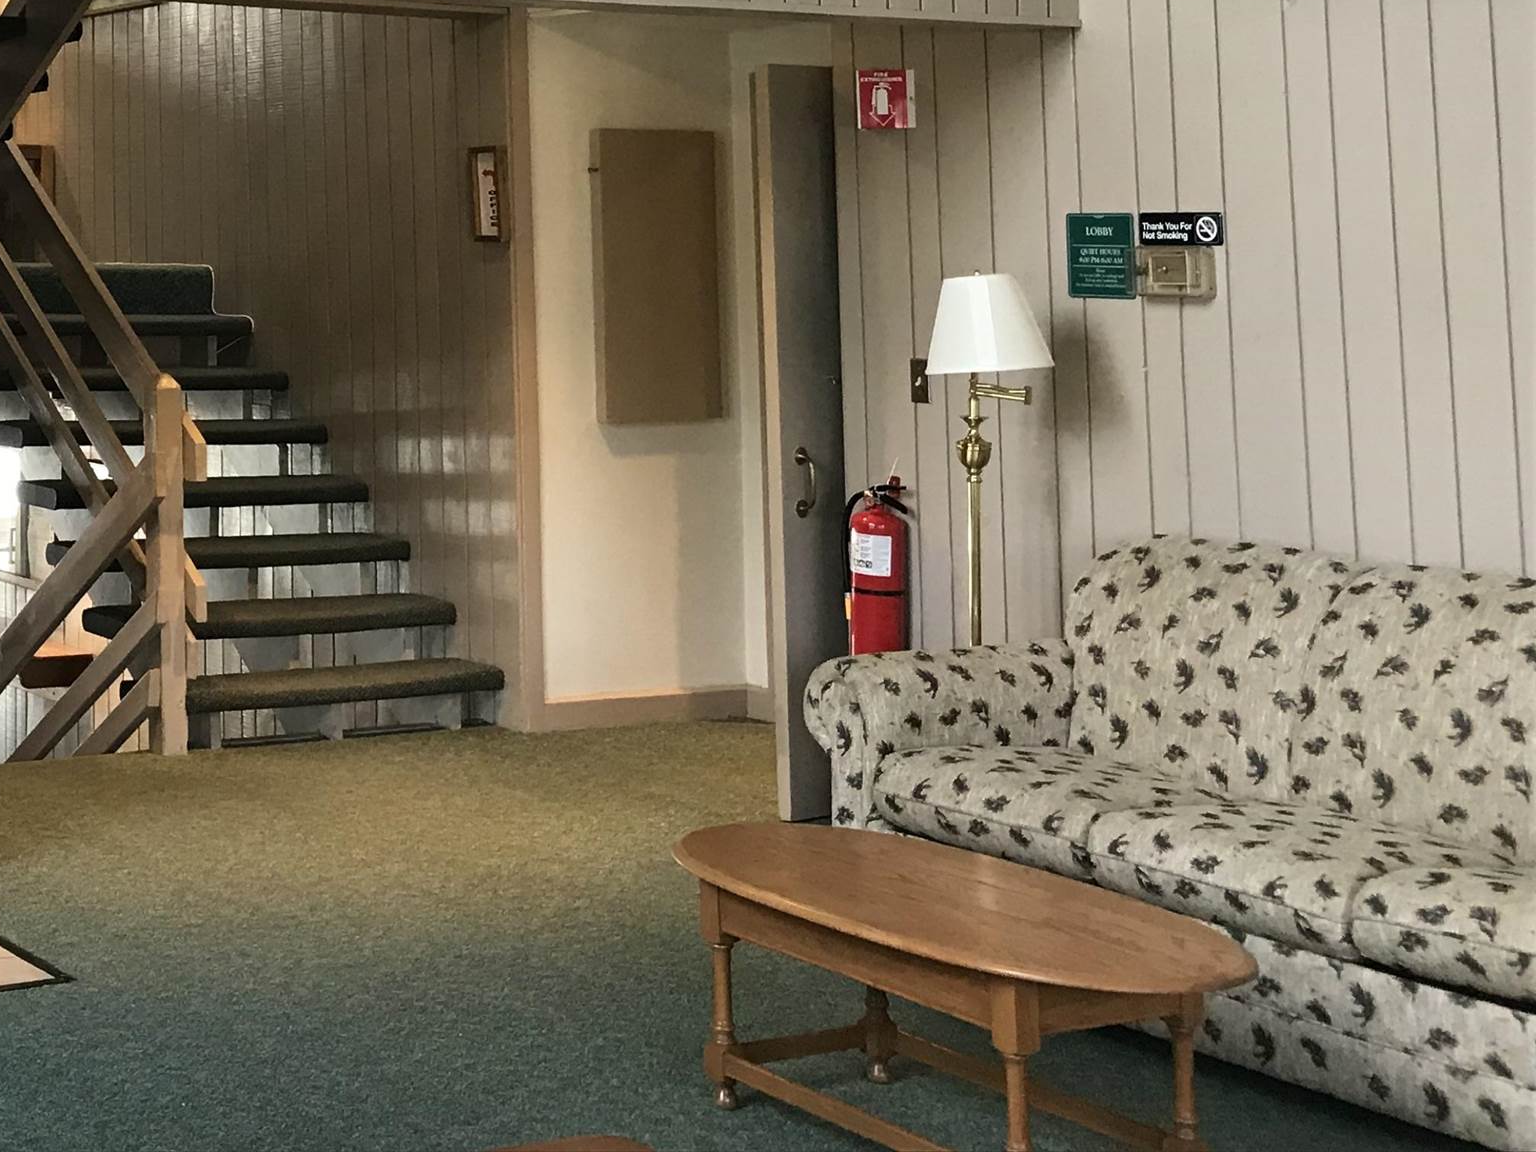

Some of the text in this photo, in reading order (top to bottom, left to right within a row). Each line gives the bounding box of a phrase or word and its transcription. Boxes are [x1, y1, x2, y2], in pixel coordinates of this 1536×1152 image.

[1085, 226, 1114, 236] LOBBY
[1142, 222, 1192, 231] Thank You For
[1142, 231, 1188, 242] Not Smoking
